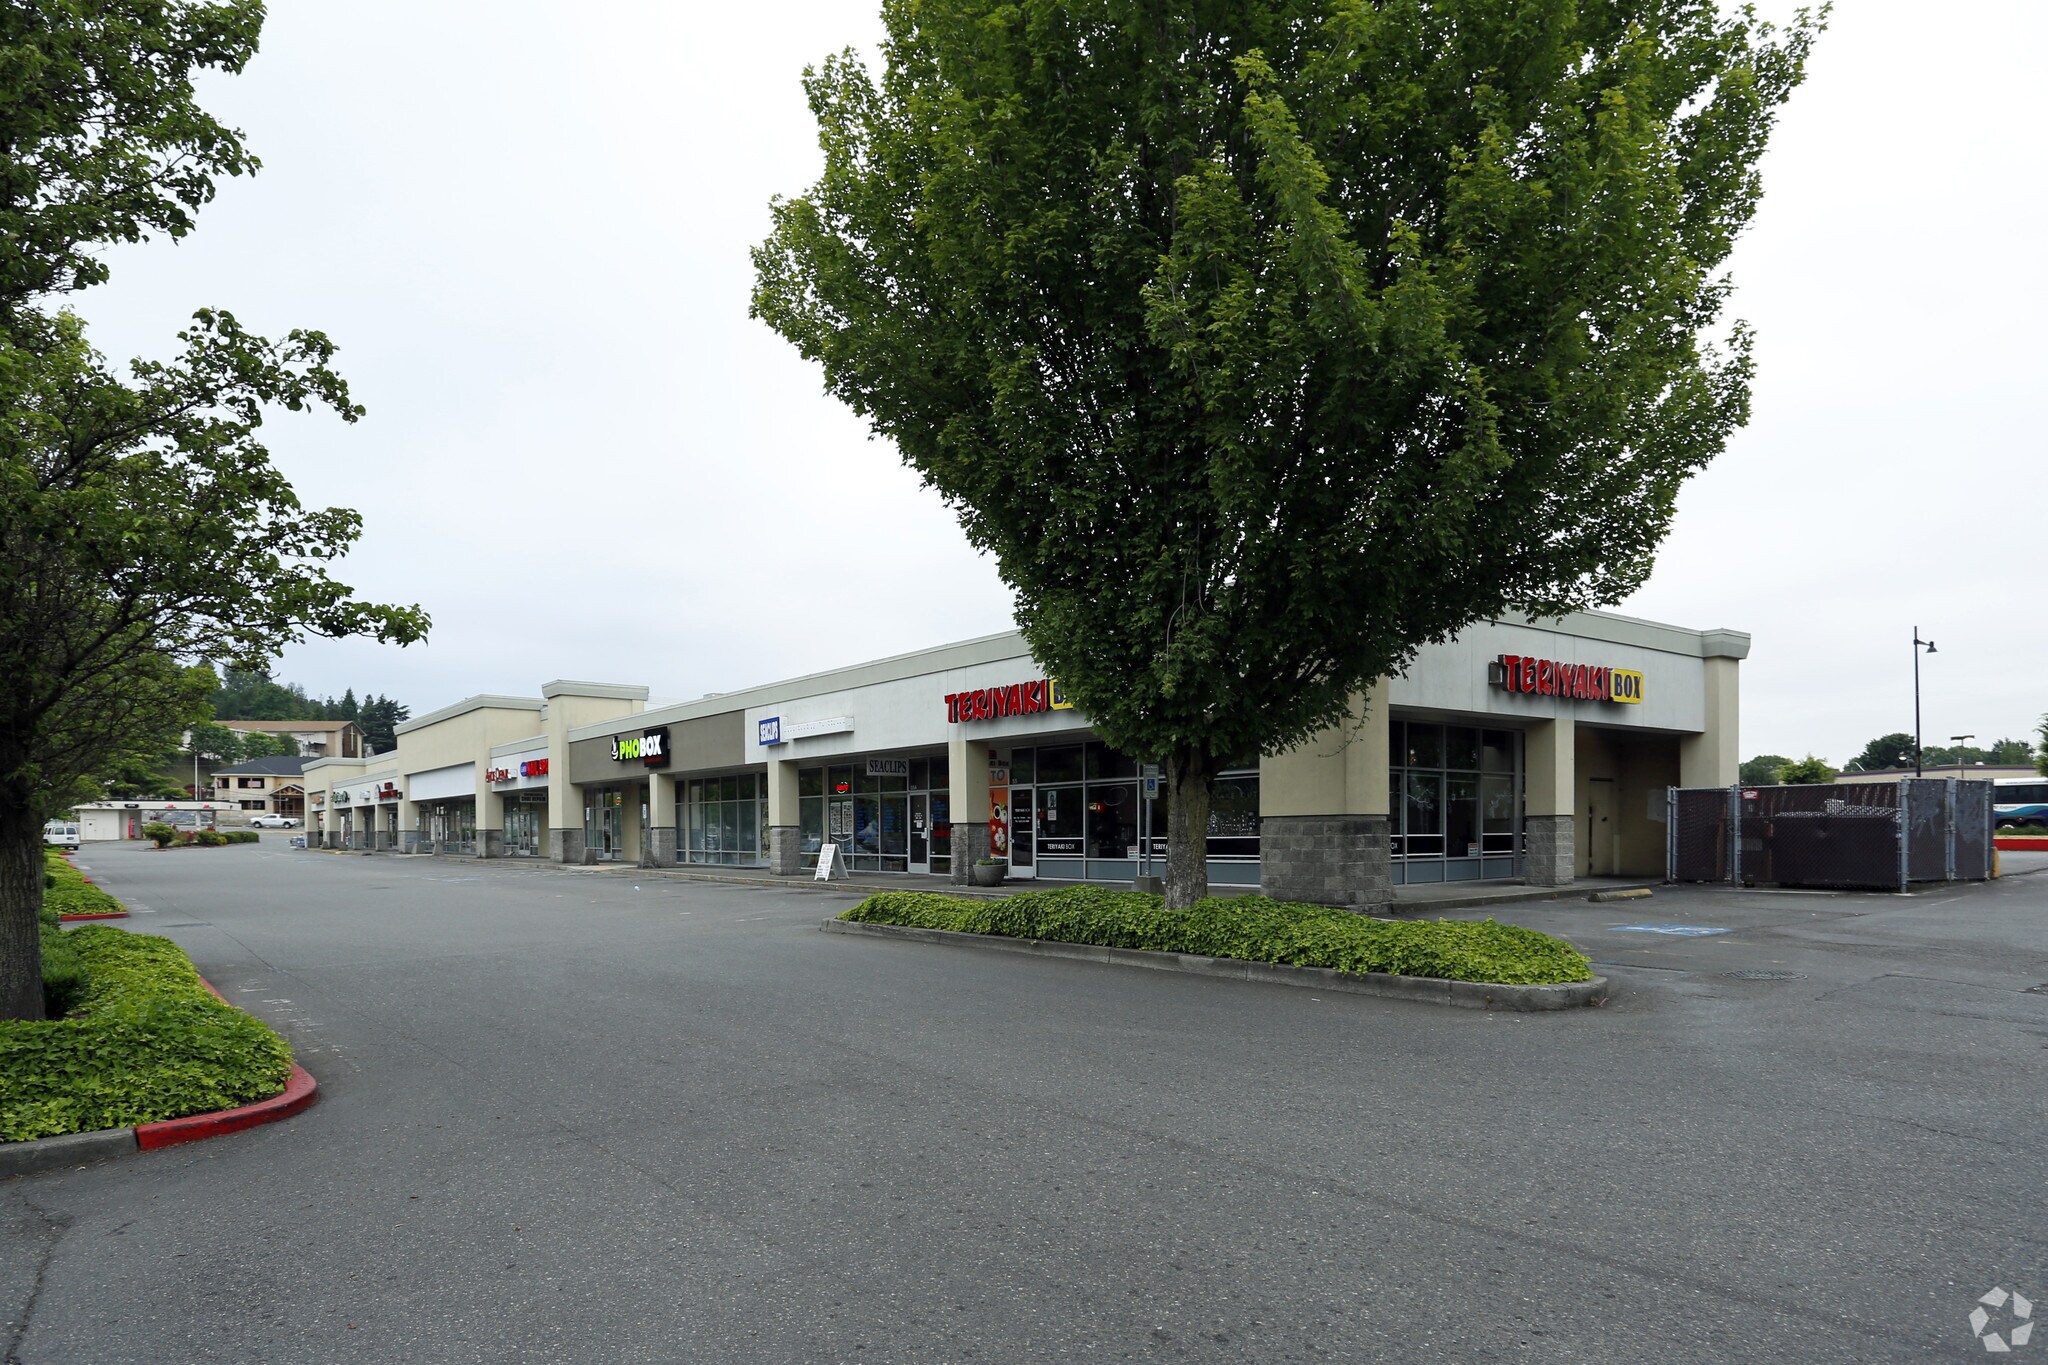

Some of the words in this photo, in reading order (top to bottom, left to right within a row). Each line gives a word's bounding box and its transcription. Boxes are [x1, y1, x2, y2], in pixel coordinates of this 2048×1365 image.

[1504, 654, 1609, 700] TERIYAKI
[1614, 673, 1641, 699] BOX
[944, 679, 1047, 723] TERIYAKI
[869, 760, 907, 773] SEACLIPS
